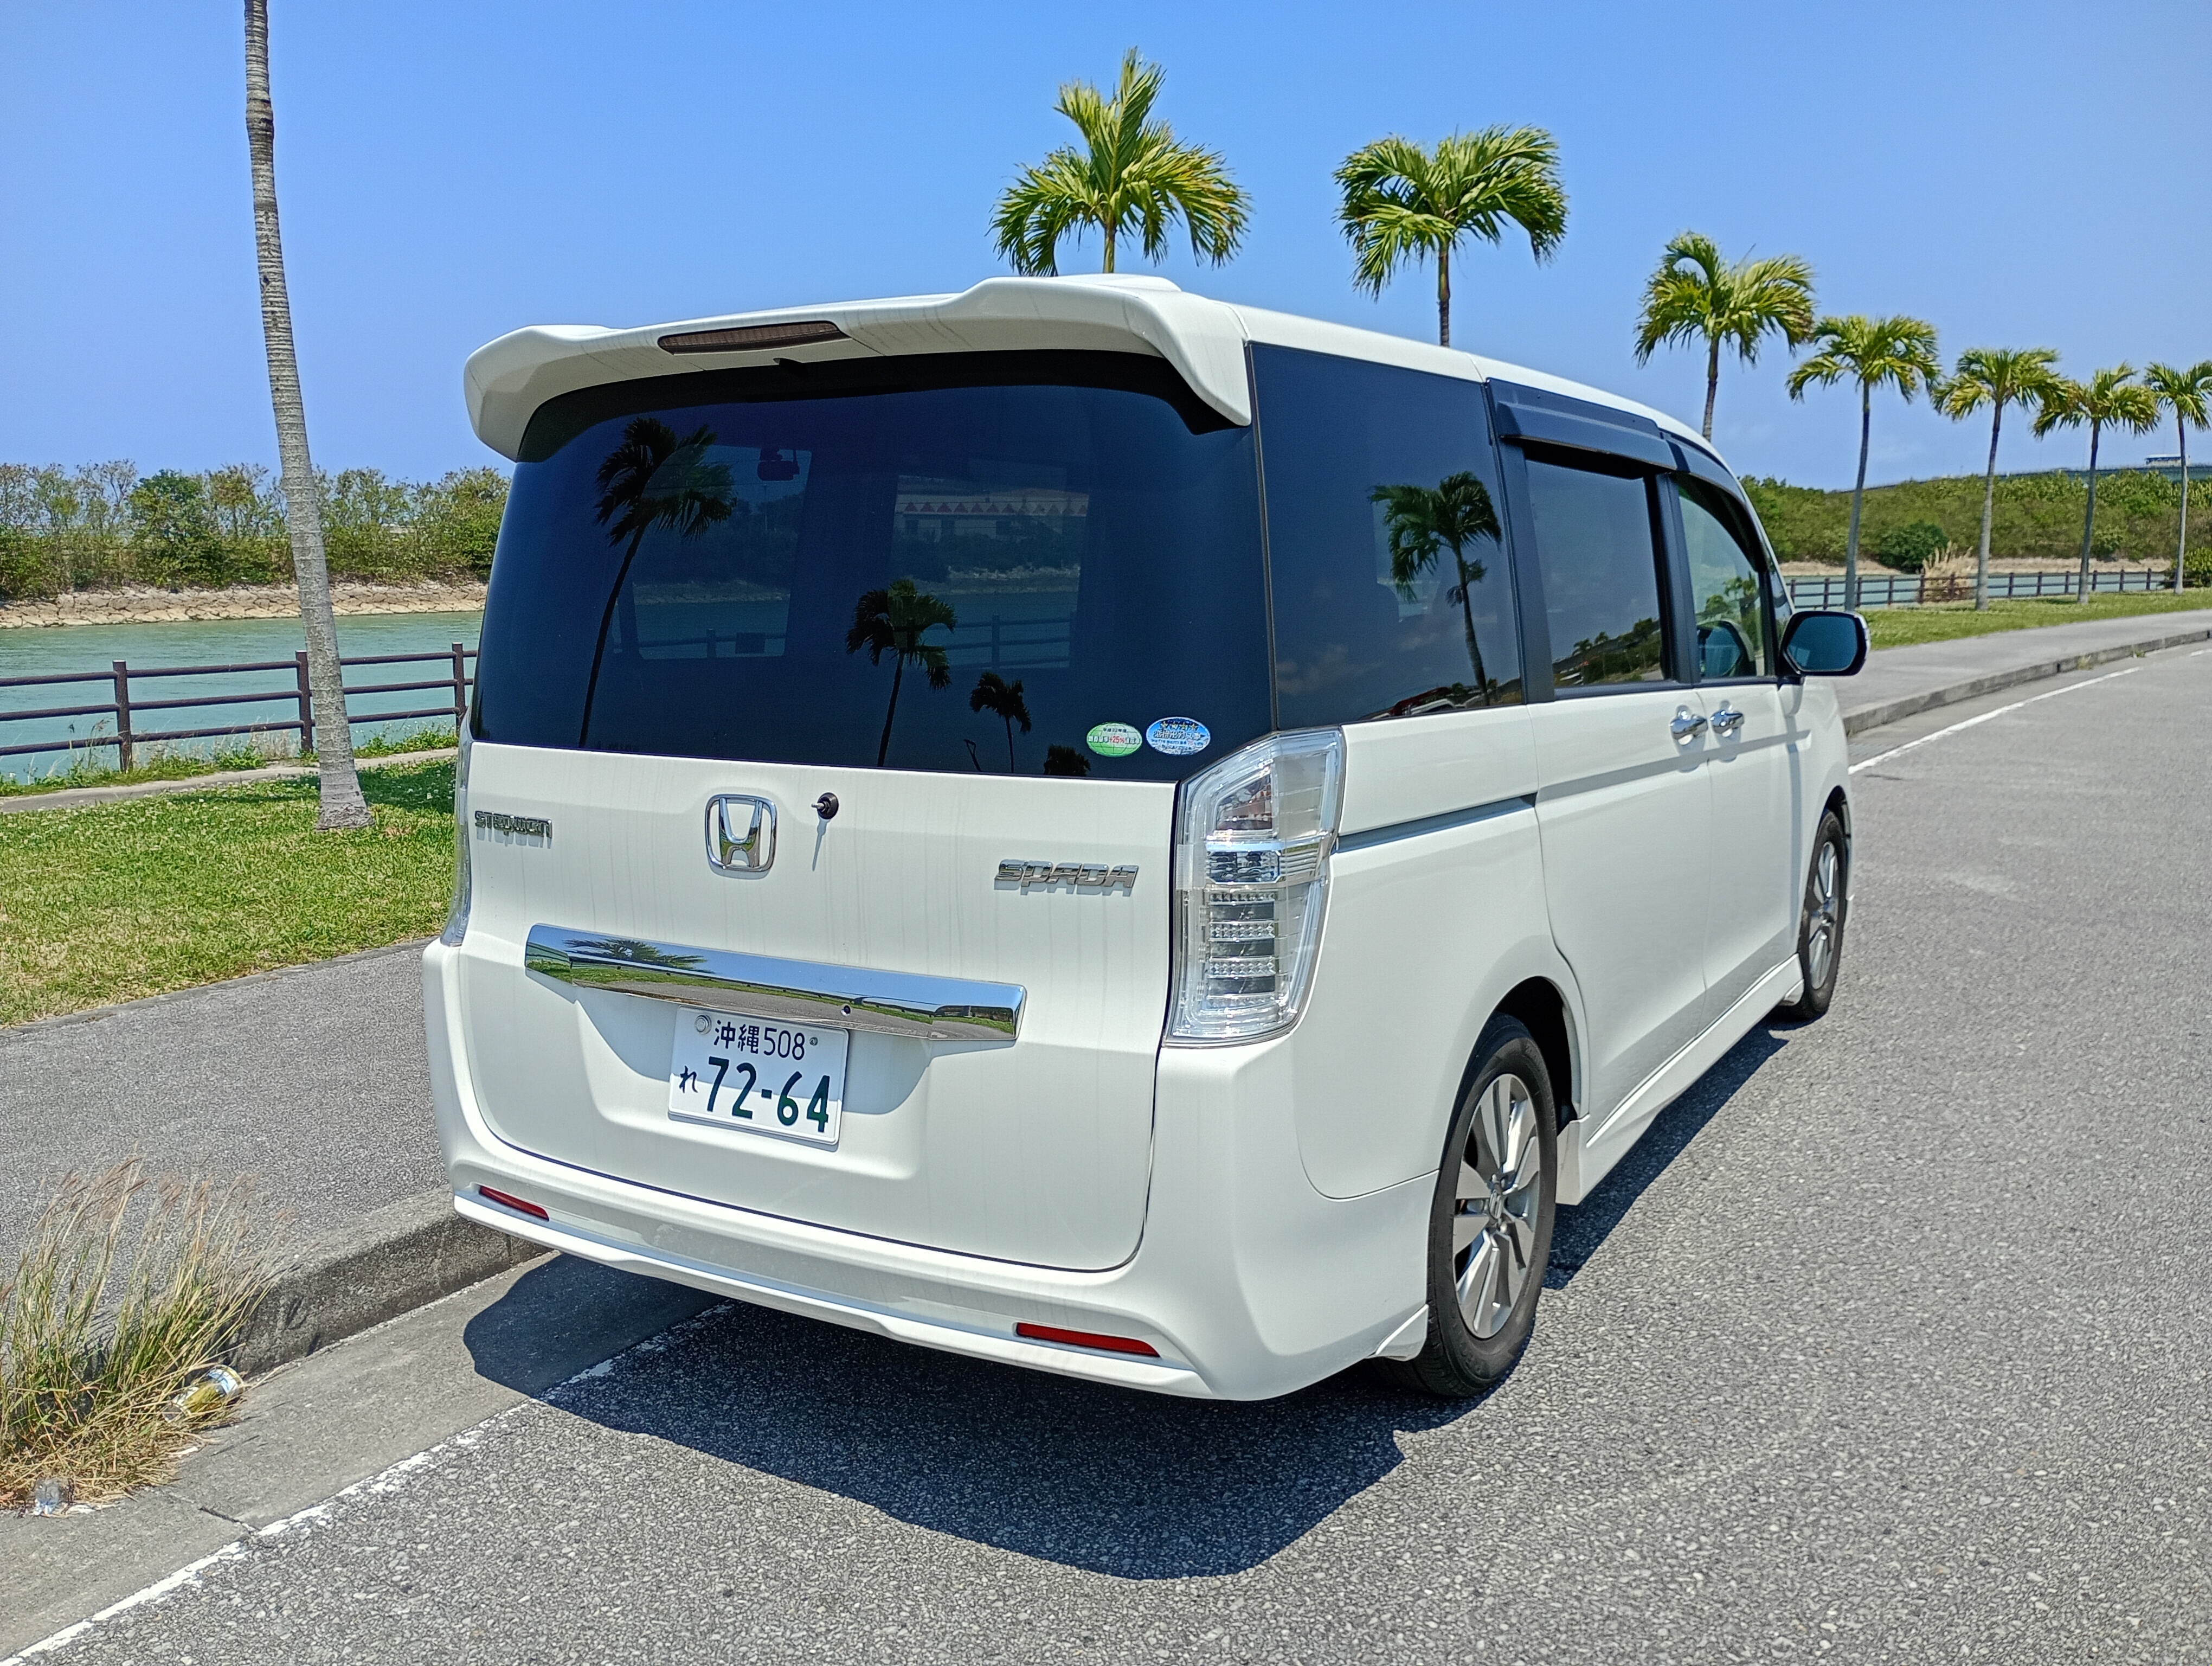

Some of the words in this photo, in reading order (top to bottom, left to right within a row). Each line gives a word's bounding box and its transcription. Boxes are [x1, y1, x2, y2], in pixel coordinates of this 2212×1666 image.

[994, 859, 1139, 888] SPADA
[679, 1066, 699, 1093] れ
[706, 1056, 831, 1133] 72-64
